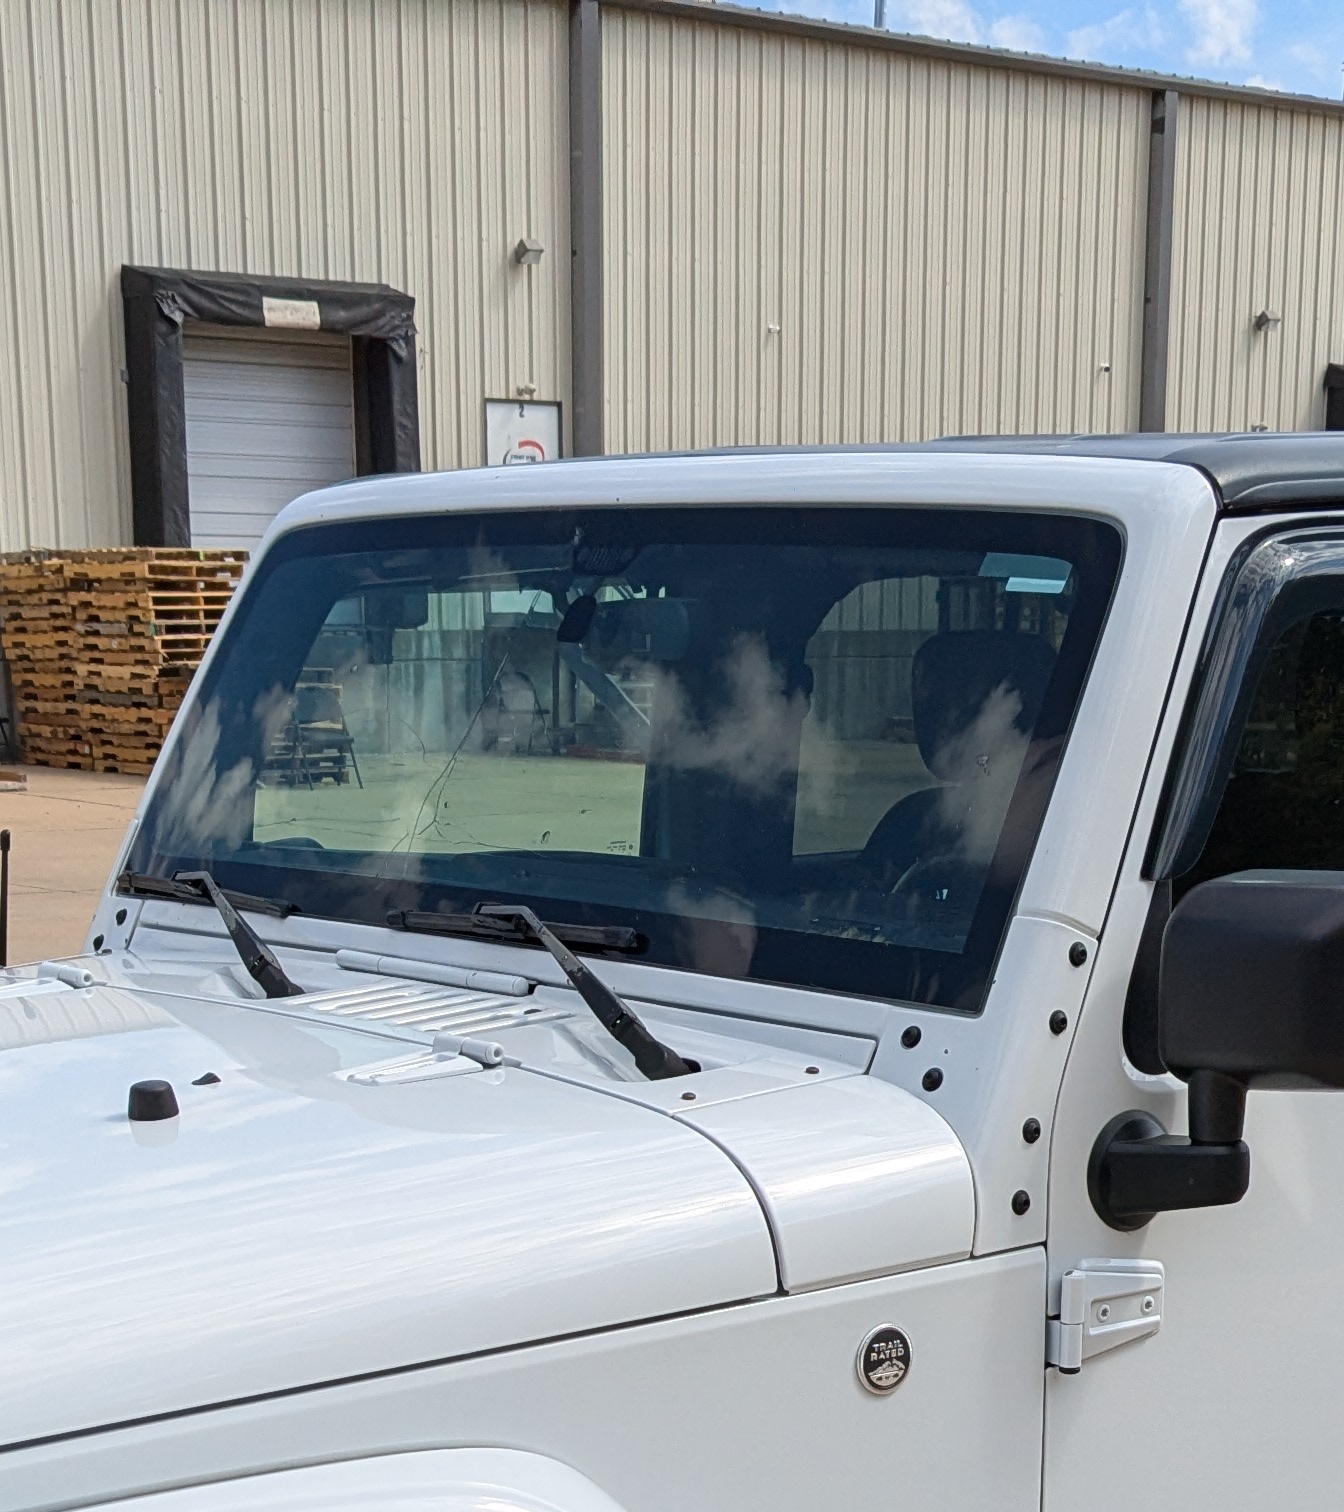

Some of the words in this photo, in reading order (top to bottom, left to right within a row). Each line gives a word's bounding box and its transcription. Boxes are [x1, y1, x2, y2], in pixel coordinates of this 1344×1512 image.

[518, 402, 525, 418] 2
[871, 1339, 904, 1352] TRAIL
[870, 1348, 905, 1362] RATED
